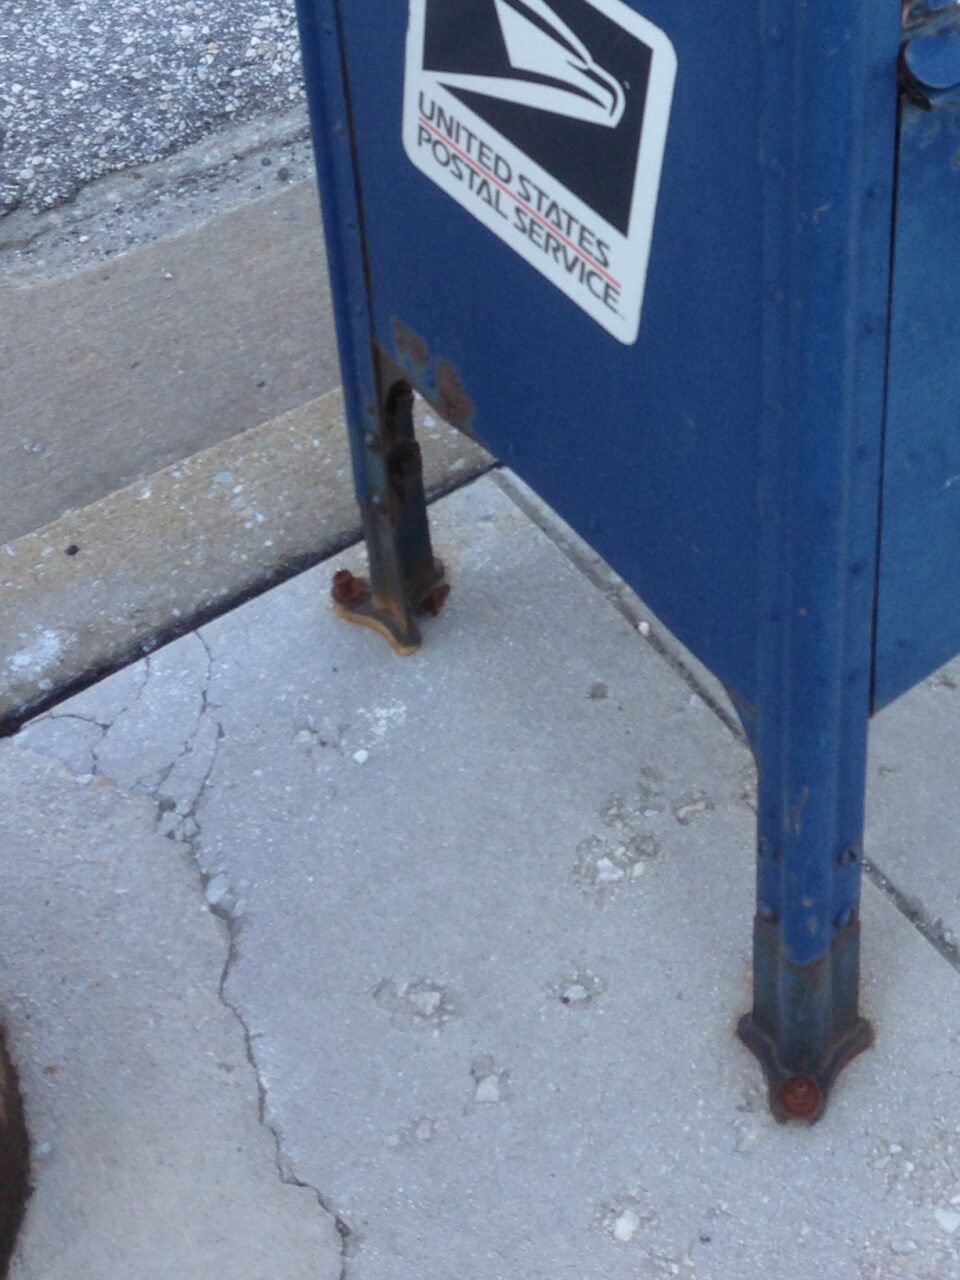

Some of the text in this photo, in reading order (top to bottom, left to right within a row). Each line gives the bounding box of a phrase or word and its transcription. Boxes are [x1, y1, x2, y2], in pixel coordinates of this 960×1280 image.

[417, 122, 622, 315] POSTAL SERVICE
[418, 90, 611, 270] UNITED STATES
